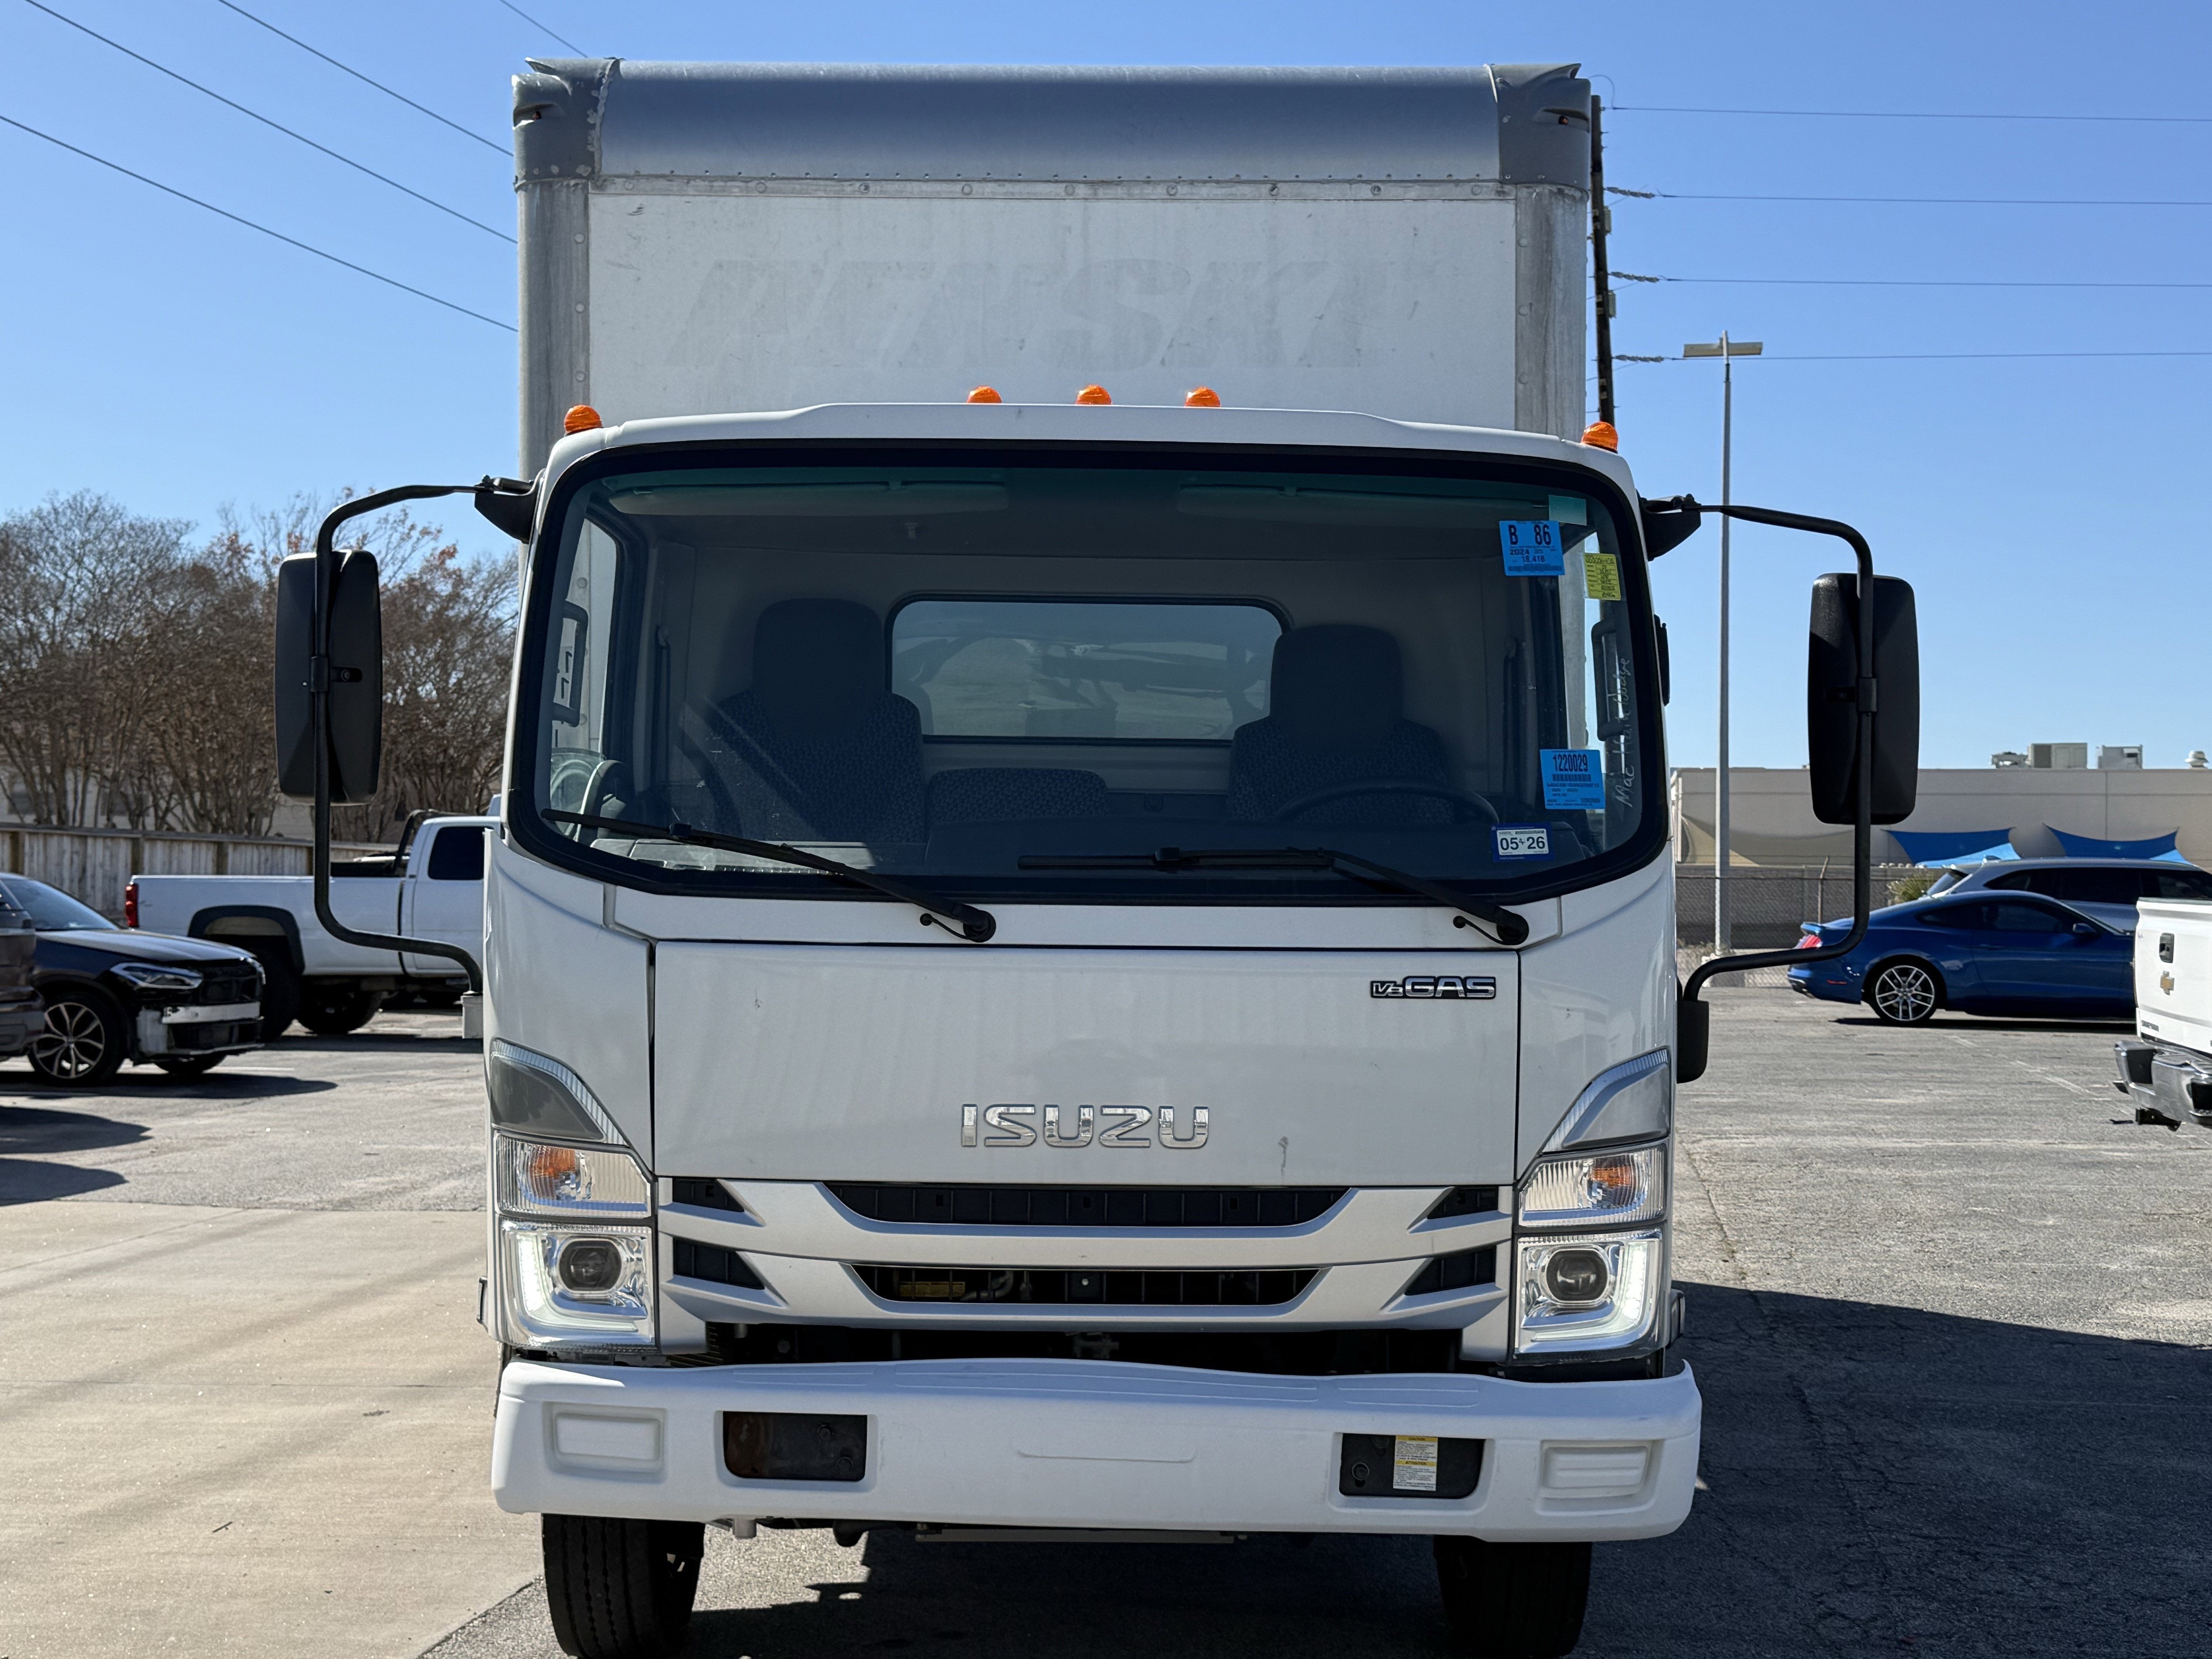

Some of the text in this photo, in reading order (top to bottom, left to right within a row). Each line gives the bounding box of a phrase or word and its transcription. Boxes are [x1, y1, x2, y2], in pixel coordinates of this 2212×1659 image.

[1508, 524, 1551, 546] B 86
[1553, 754, 1588, 772] 1220029
[1500, 836, 1545, 850] 05 26
[961, 1104, 1209, 1149] ISUZU
